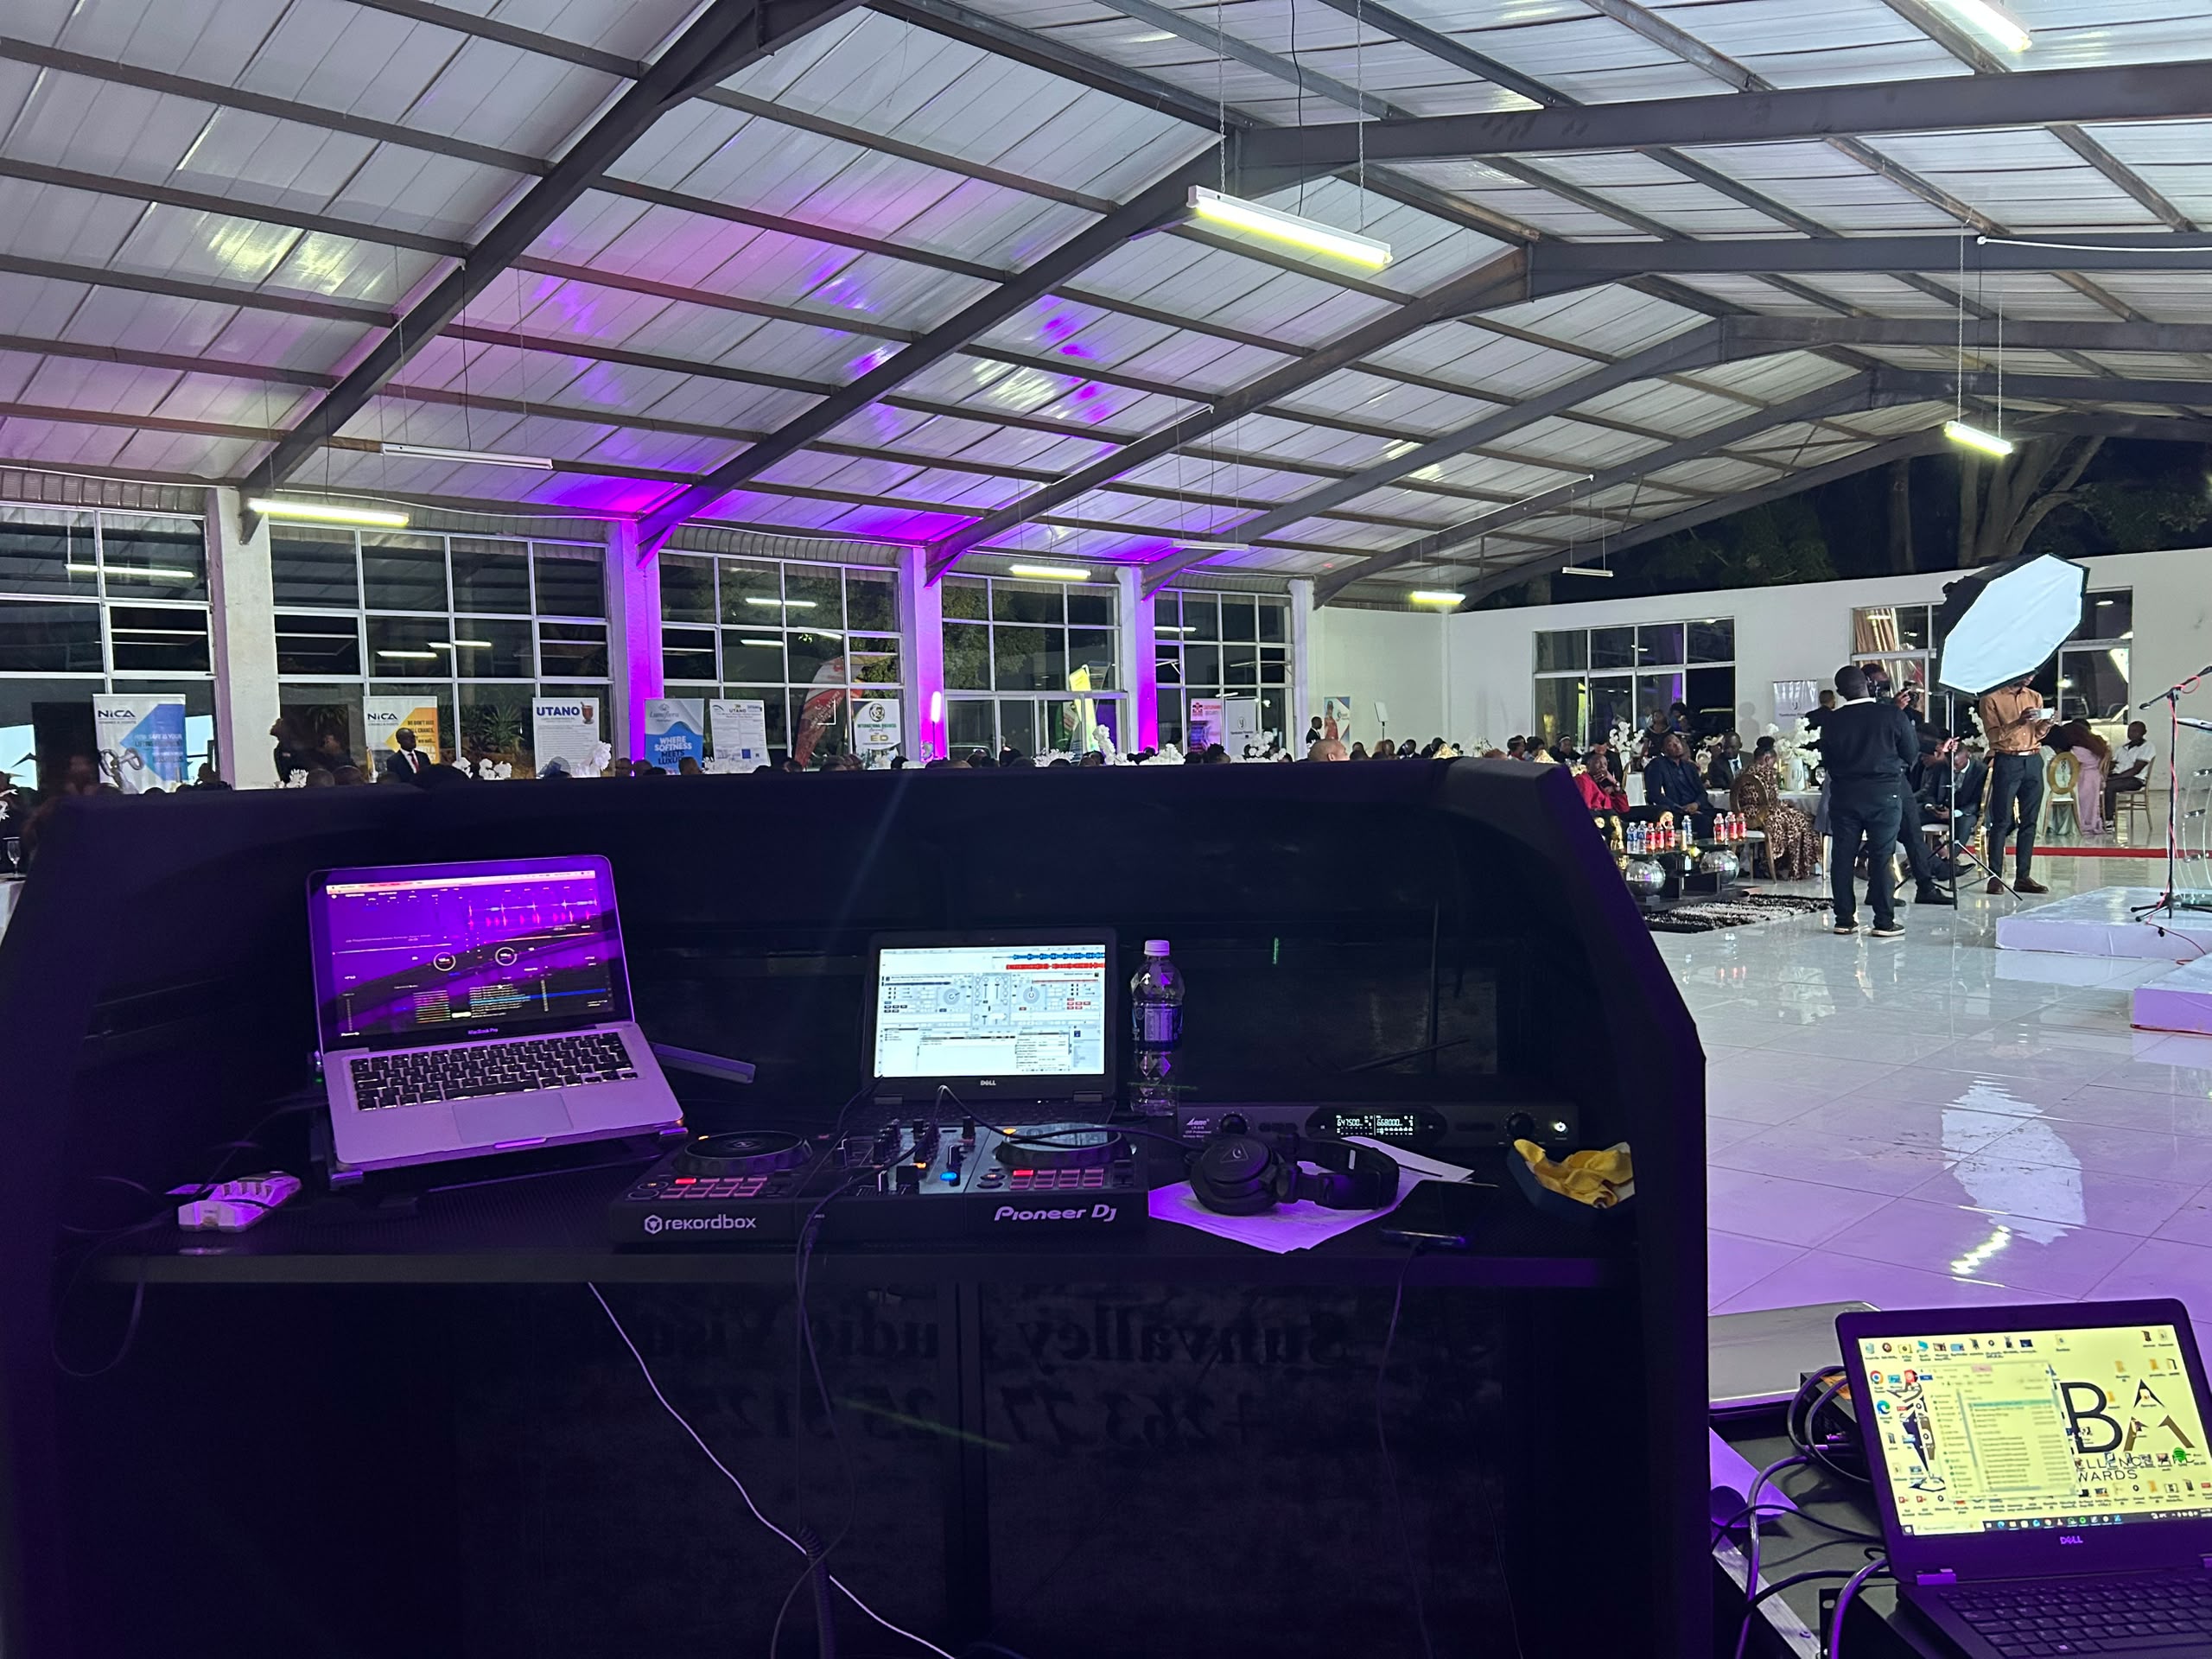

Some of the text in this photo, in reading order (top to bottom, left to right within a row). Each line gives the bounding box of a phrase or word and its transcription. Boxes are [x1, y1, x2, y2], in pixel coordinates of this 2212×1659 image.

[536, 706, 580, 716] UTANO
[654, 742, 692, 752] SOFTNESS
[995, 1205, 1087, 1221] Pioneer
[664, 1213, 757, 1230] rekordbox
[2060, 1535, 2083, 1544] DELL
